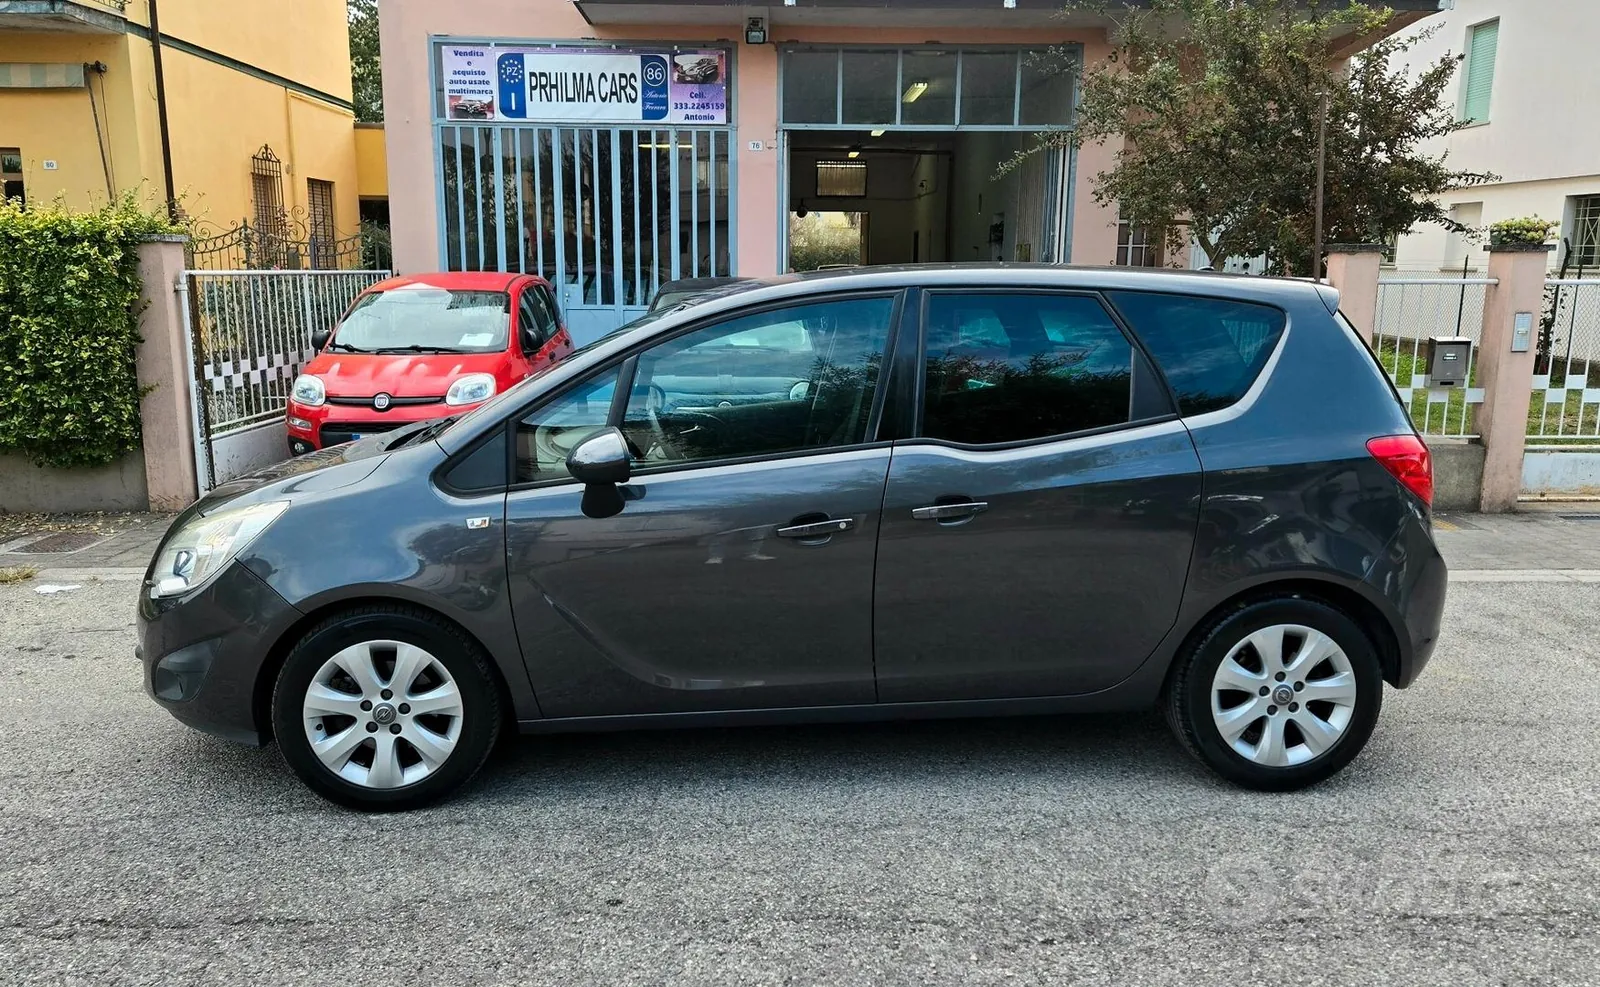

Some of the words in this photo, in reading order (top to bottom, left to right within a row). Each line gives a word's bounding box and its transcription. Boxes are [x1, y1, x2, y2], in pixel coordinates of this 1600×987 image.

[452, 69, 486, 77] acquisto
[506, 67, 518, 76] PZ
[646, 67, 662, 81] 86
[529, 71, 596, 103] PRHILMA
[598, 72, 638, 104] CARS
[674, 102, 725, 110] 333.2245159
[684, 113, 715, 121] Antonio
